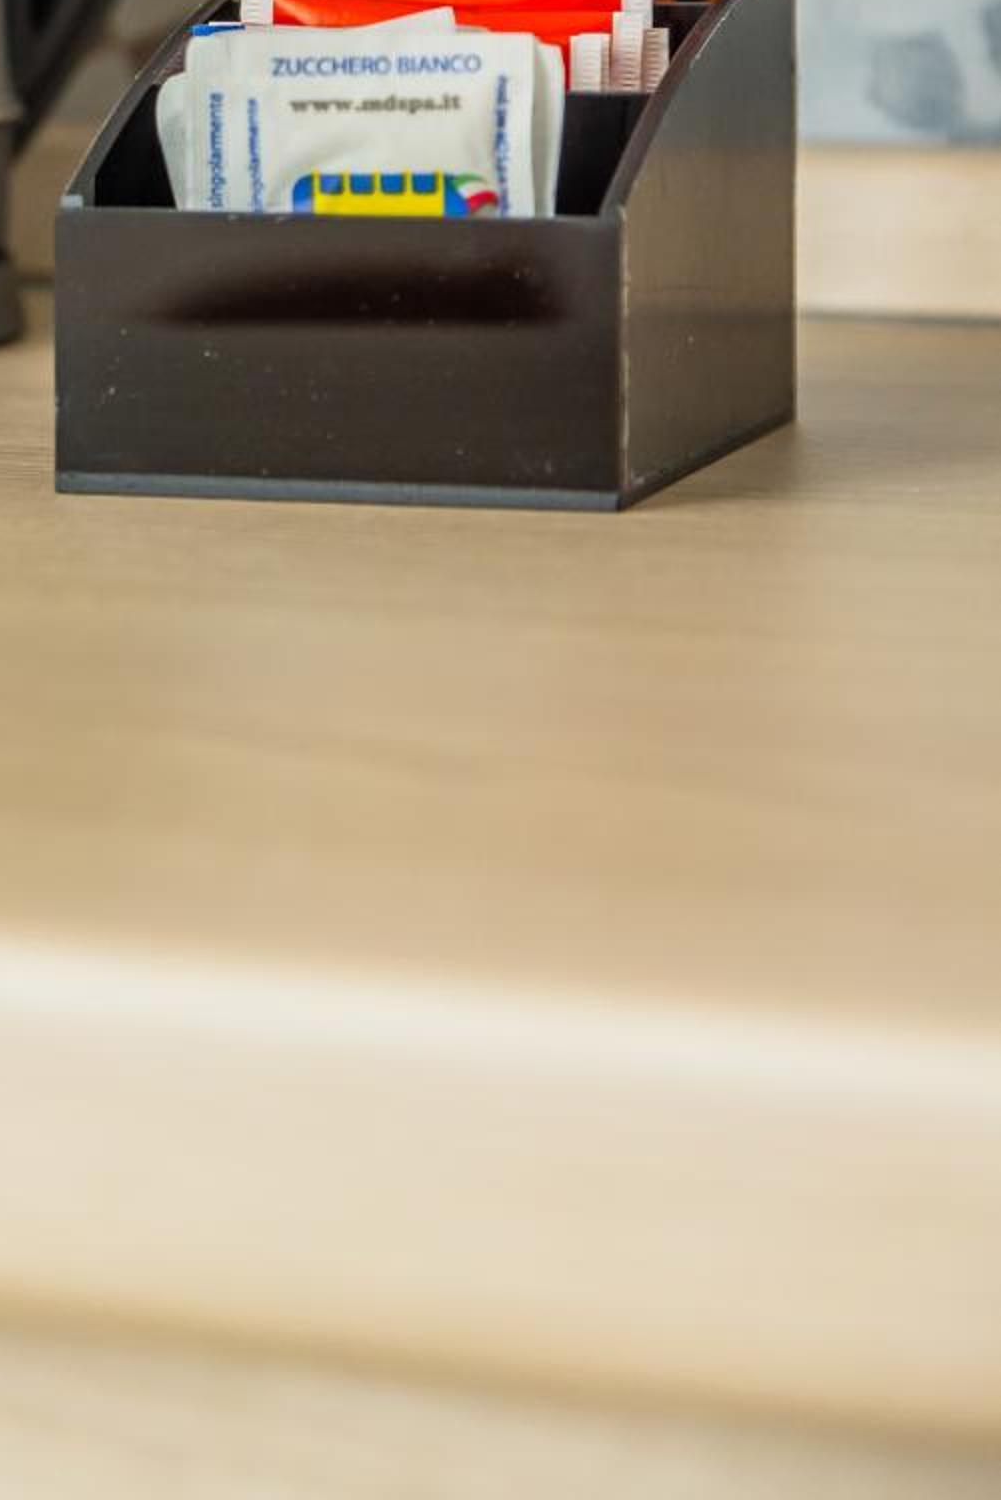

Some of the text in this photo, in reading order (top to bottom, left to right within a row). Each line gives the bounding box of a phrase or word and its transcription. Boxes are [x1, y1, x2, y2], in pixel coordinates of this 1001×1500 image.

[272, 54, 482, 77] ZUCCHERO BIANCO
[290, 94, 462, 114] www.mdspa.it
[207, 92, 226, 208] singolamente
